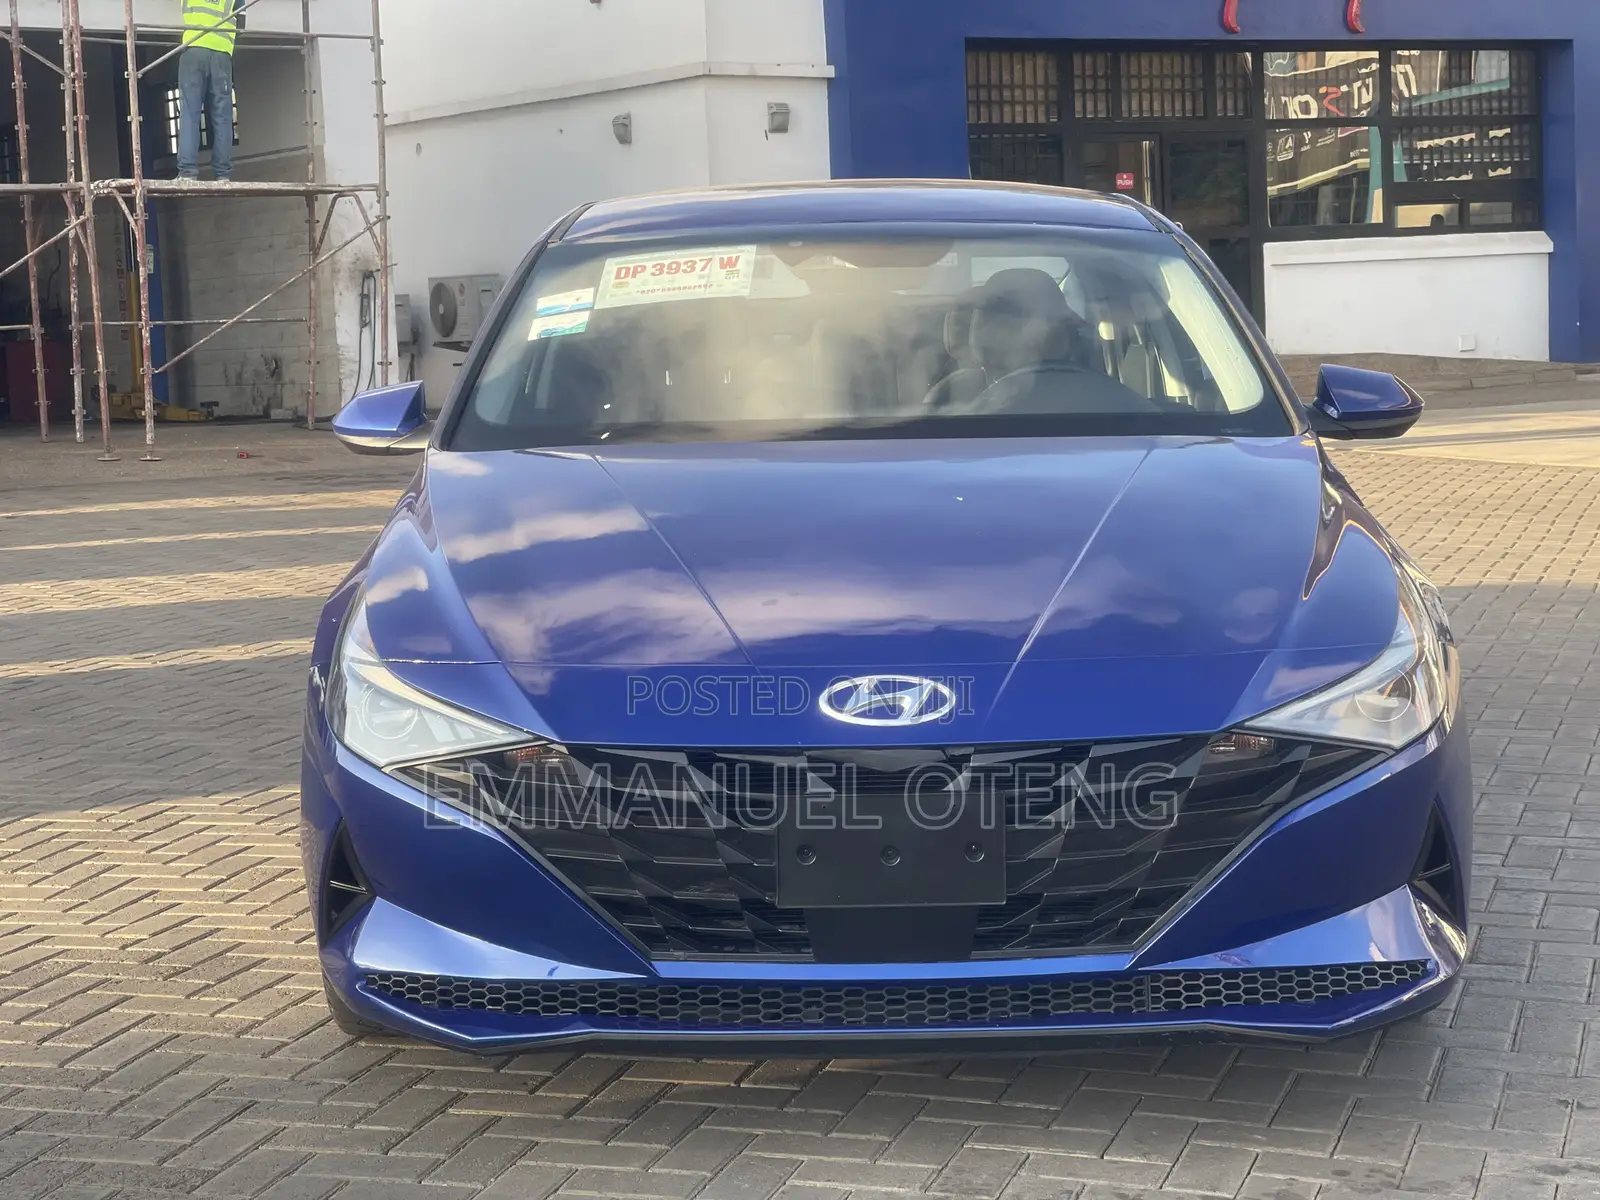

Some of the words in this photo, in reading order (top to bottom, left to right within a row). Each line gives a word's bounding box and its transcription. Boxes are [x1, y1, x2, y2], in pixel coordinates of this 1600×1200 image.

[614, 265, 647, 280] DP
[650, 257, 712, 276] 3937
[718, 255, 741, 270] W
